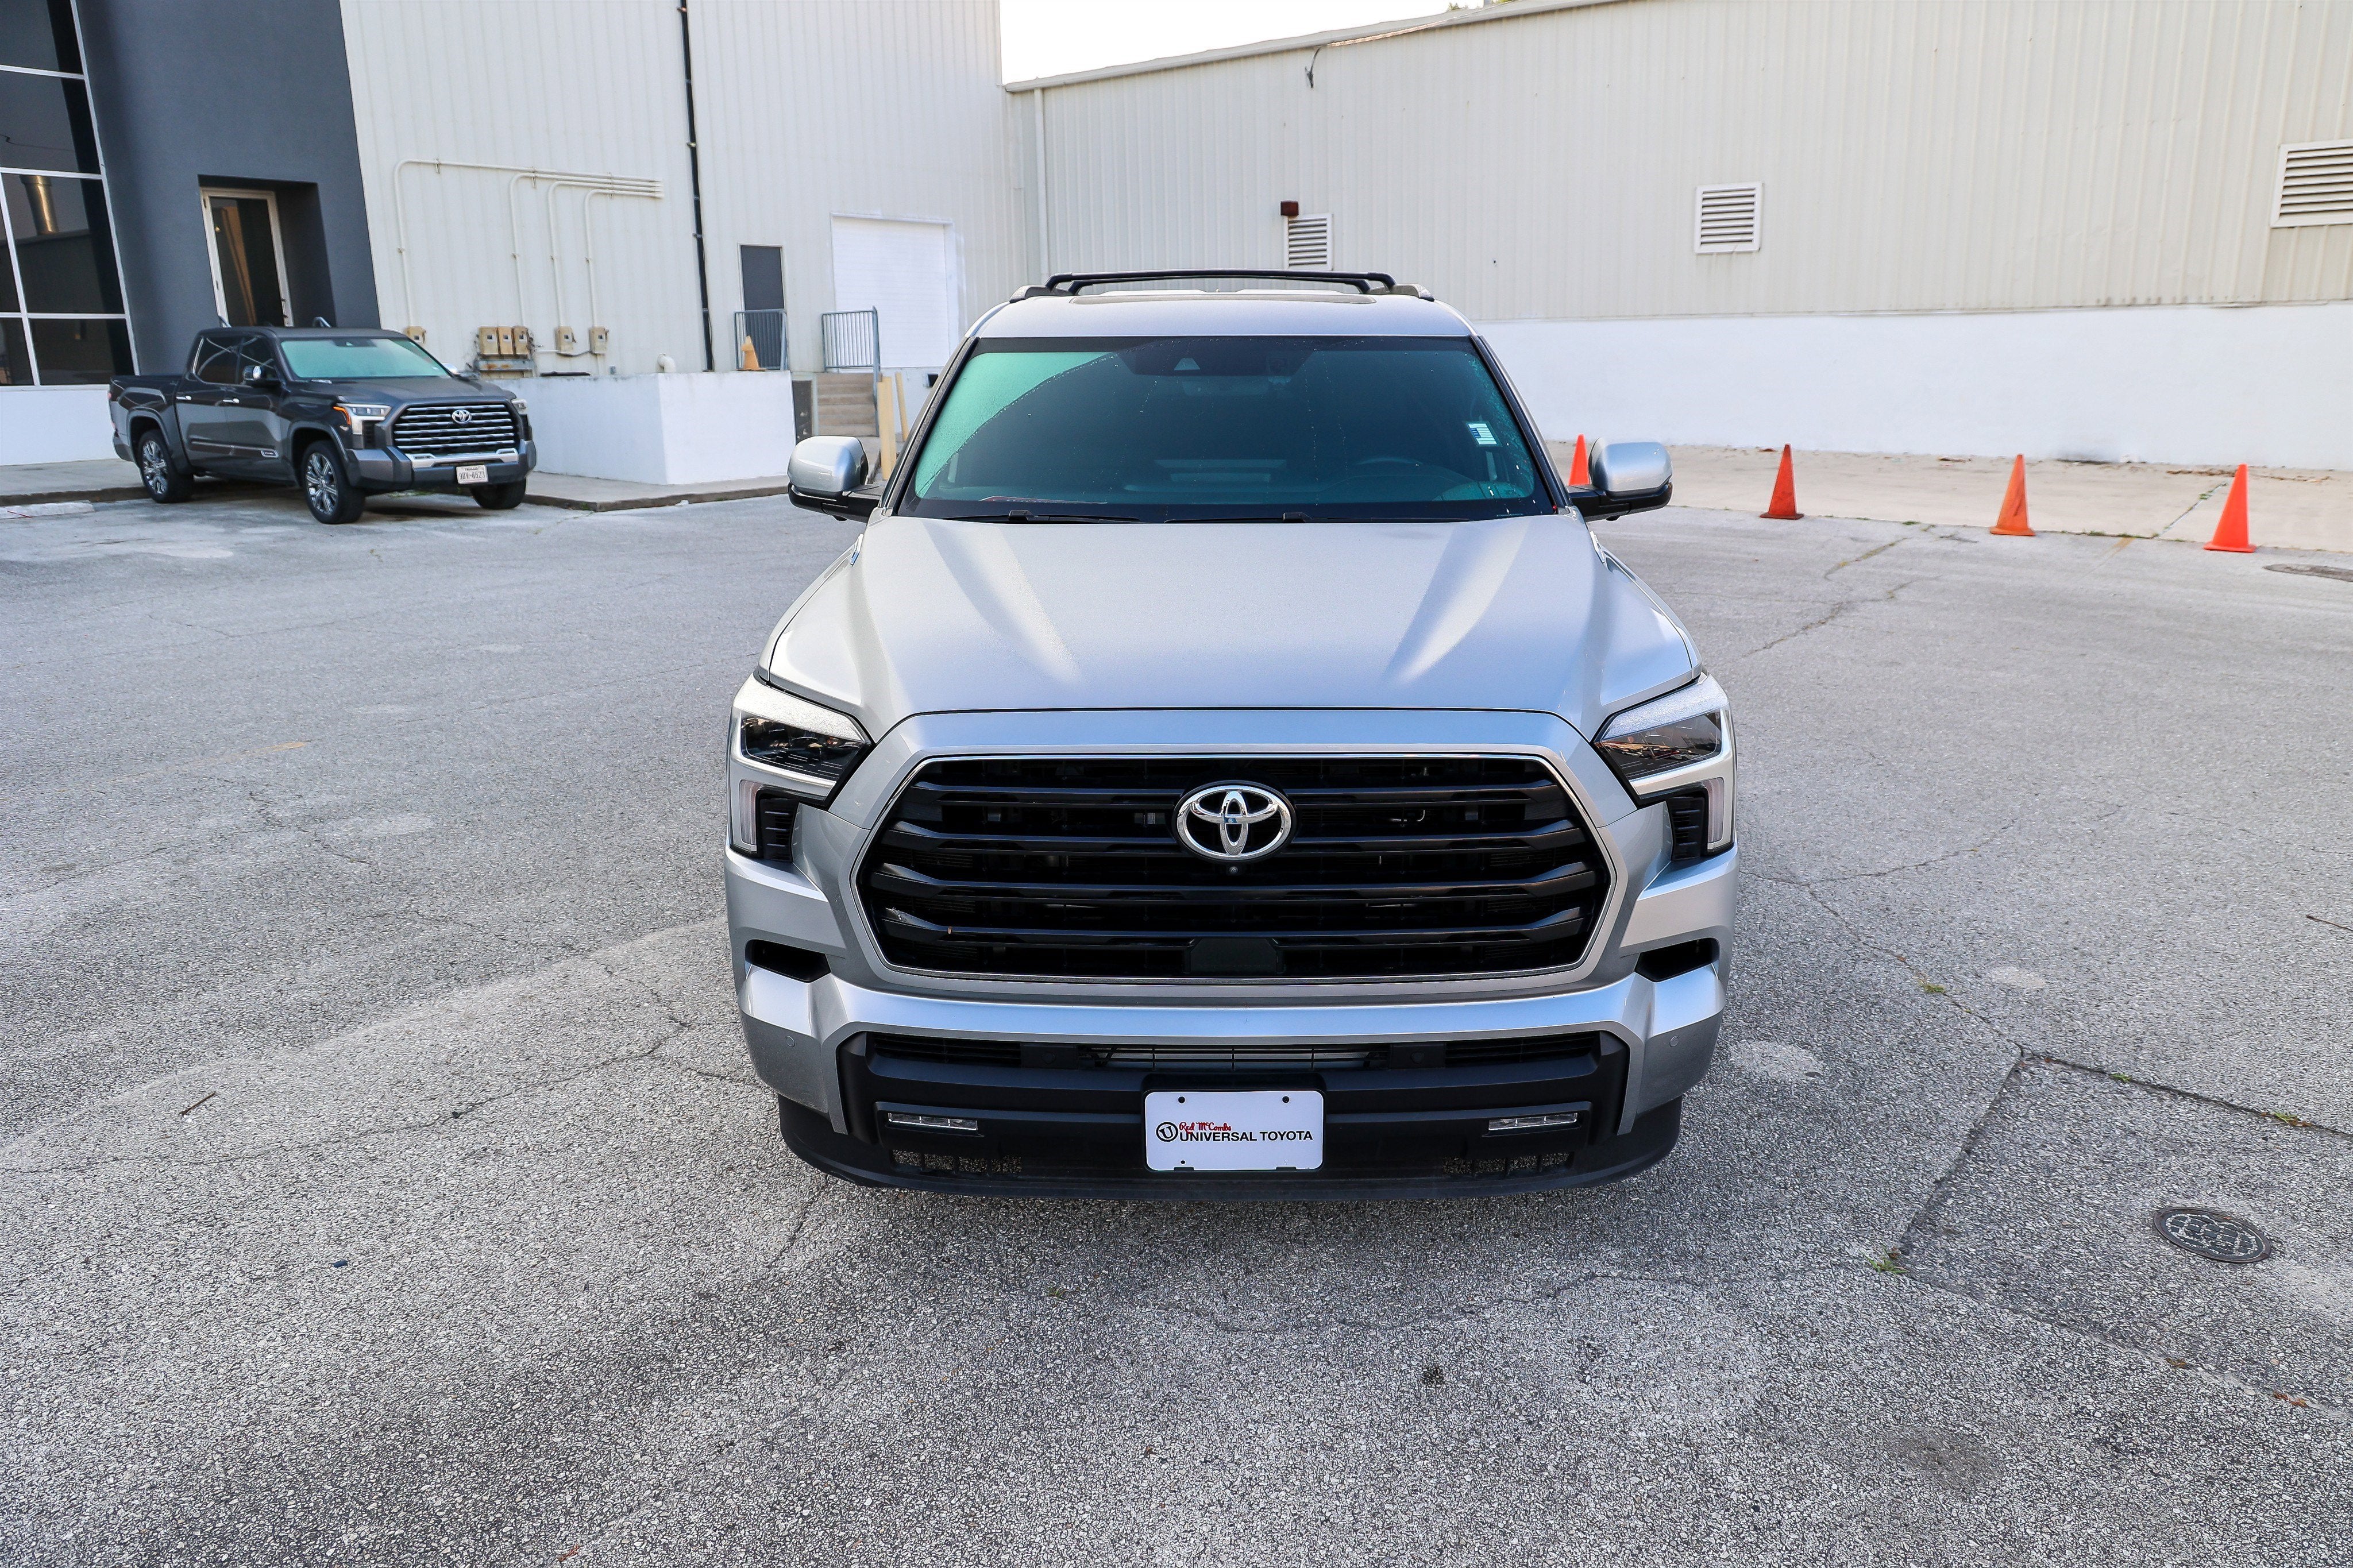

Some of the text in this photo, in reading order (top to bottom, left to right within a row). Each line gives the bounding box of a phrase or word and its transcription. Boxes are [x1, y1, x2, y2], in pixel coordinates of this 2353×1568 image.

[1179, 1122, 1232, 1133] Red McCombs
[1180, 1131, 1313, 1142] UNIVERSAL TOYOTA
